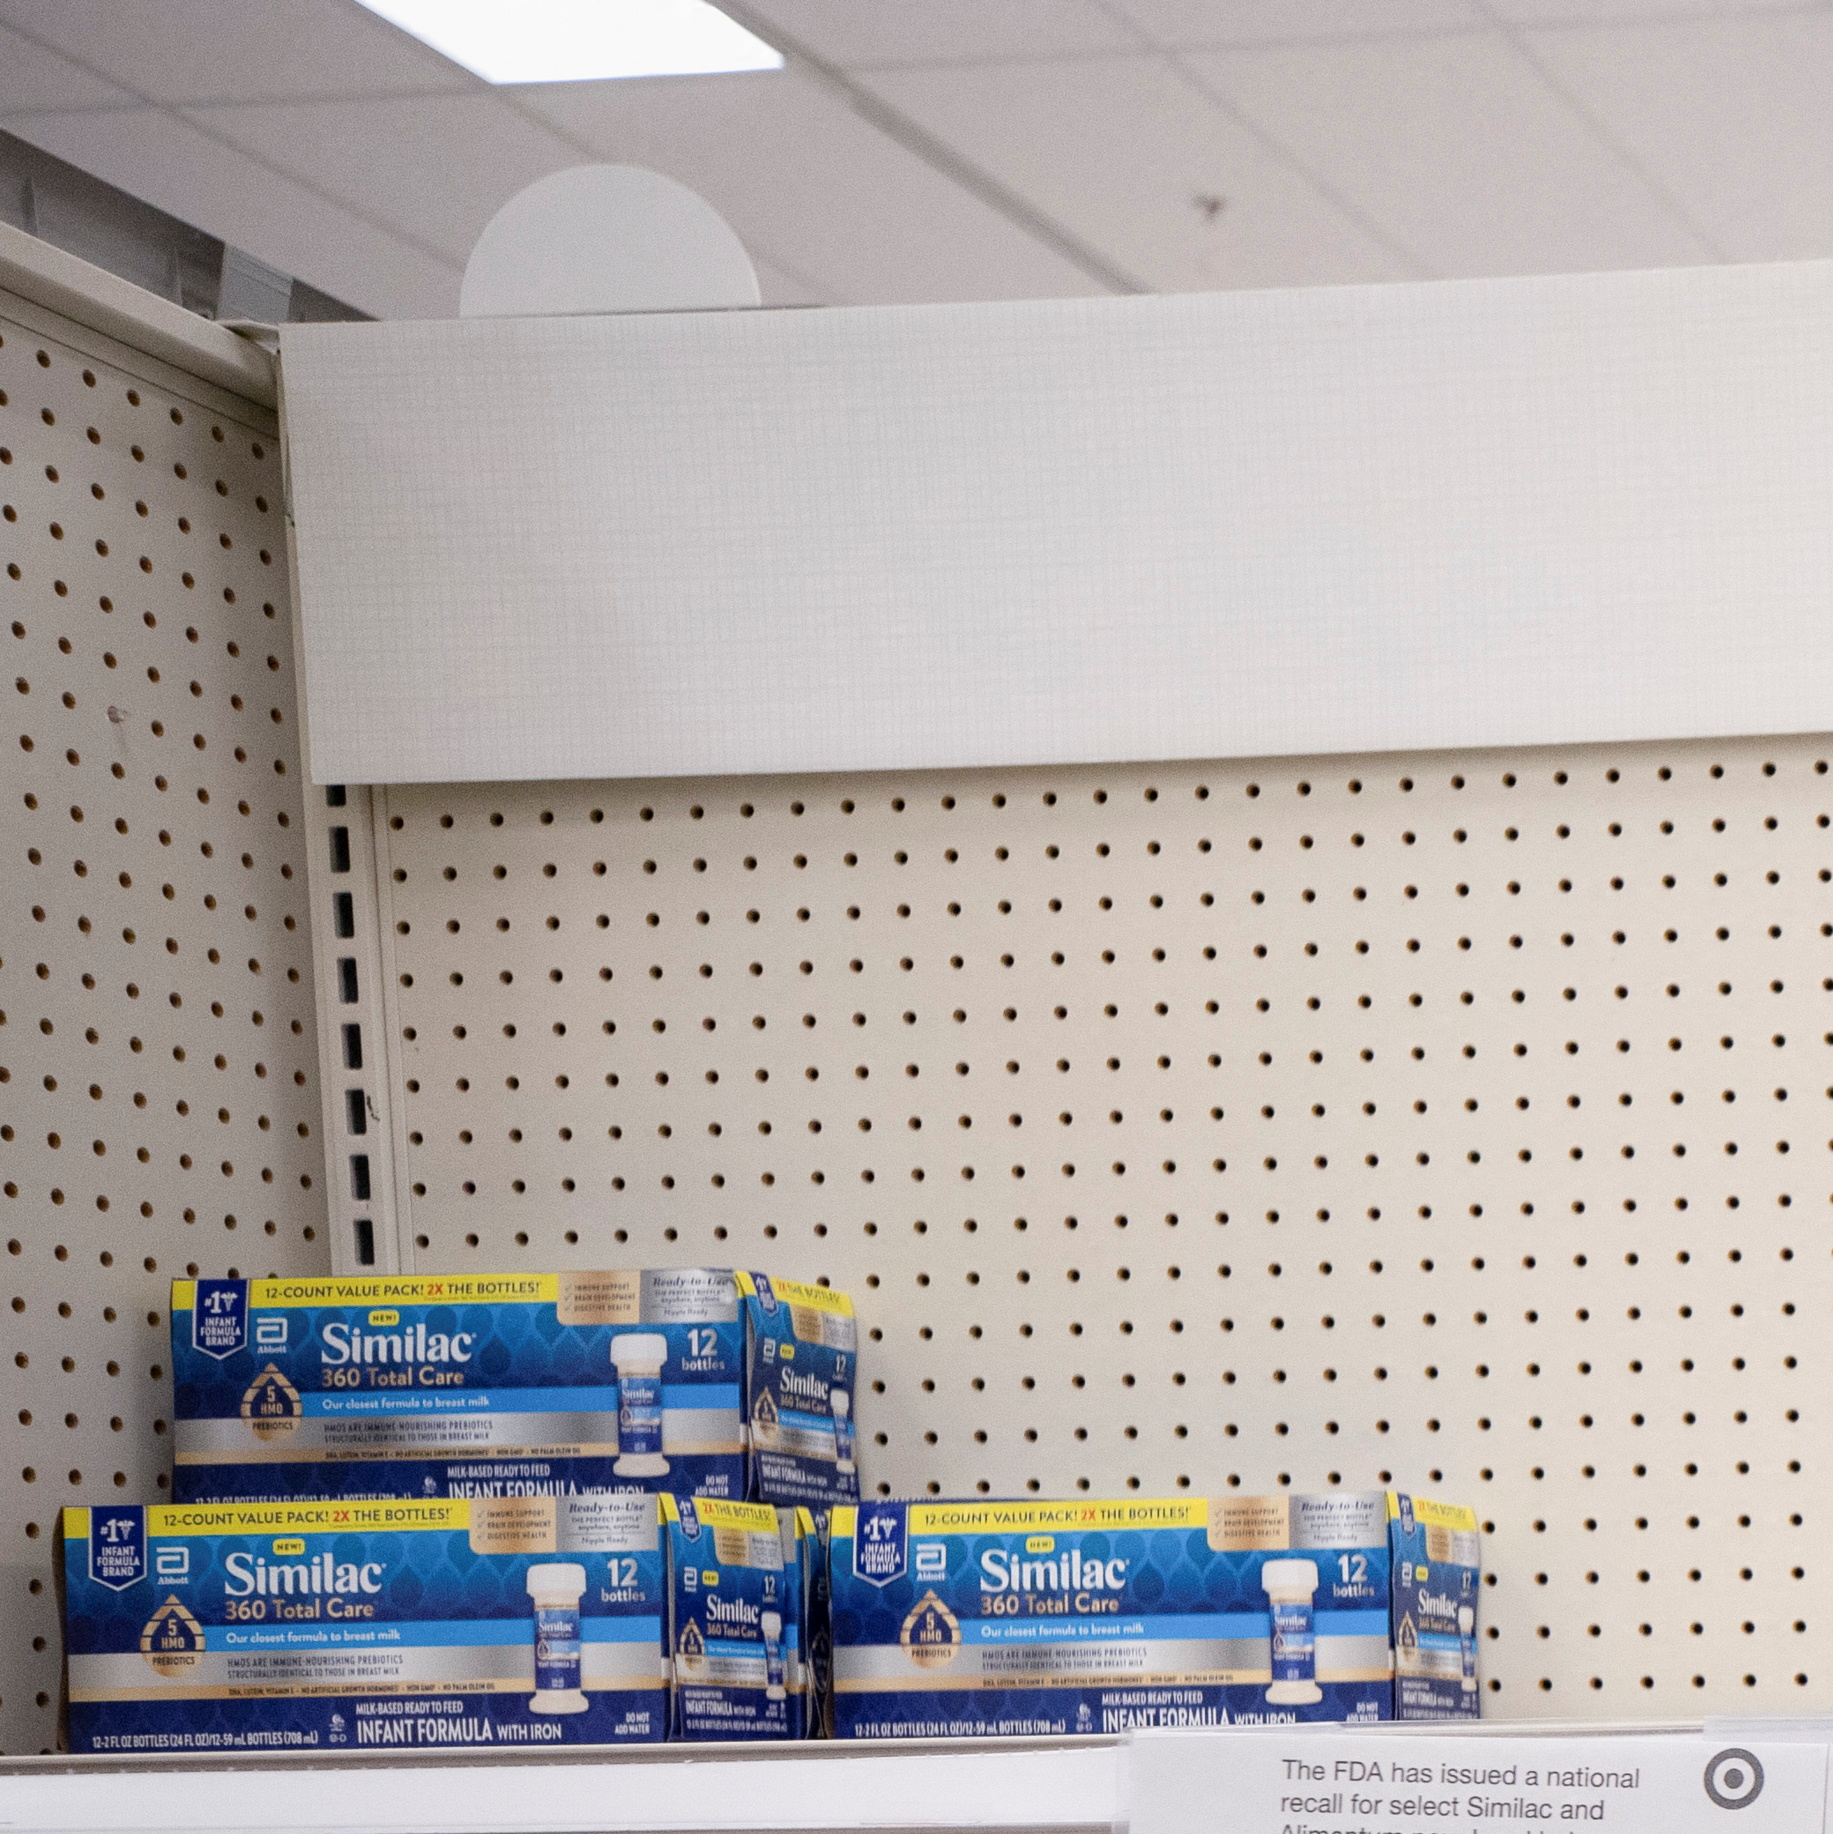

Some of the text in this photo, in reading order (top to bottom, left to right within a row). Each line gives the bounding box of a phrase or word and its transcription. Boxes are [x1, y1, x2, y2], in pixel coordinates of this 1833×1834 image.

[266, 1282, 539, 1298] 12-COUNT VALUE PACK! 2X THE BOTTLES!
[321, 1323, 472, 1364] Similac
[688, 1329, 717, 1356] 12
[682, 1357, 725, 1370] bottles
[322, 1366, 464, 1387] 360 Total Care
[780, 1366, 828, 1400] Similac
[164, 1508, 449, 1526] 12-COUNT VALUE PACK! 2X THE BOTTLES!
[925, 1514, 988, 1525] 12-COUNT
[996, 1512, 1035, 1523] VALUE
[1040, 1511, 1077, 1522] PACK!
[1081, 1510, 1096, 1520] 2X
[1100, 1509, 1124, 1520] THE
[97, 1557, 140, 1566] FORMULA
[102, 1547, 135, 1556] INFANT
[103, 1567, 134, 1577] BRAND
[158, 1576, 189, 1585] Abbott
[225, 1552, 382, 1596] Similac
[607, 1558, 638, 1587] 12
[980, 1550, 1126, 1592] Similac
[602, 1587, 645, 1601] bottles
[981, 1593, 1119, 1615] 360 Total Care
[1418, 1588, 1458, 1618] Similac
[225, 1598, 374, 1620] 360 Total Care
[706, 1594, 758, 1624] Similac
[167, 1620, 177, 1635] 5
[226, 1629, 400, 1643] Our closest formula to breast milk
[161, 1637, 185, 1649] HMO
[152, 1657, 195, 1666] PREBIOTICS
[357, 1718, 562, 1744] INFANT FORMULA WITH IRON
[1282, 1759, 1639, 1788] The FDA has issued a national
[1281, 1793, 1604, 1820] recall for select Similac and
